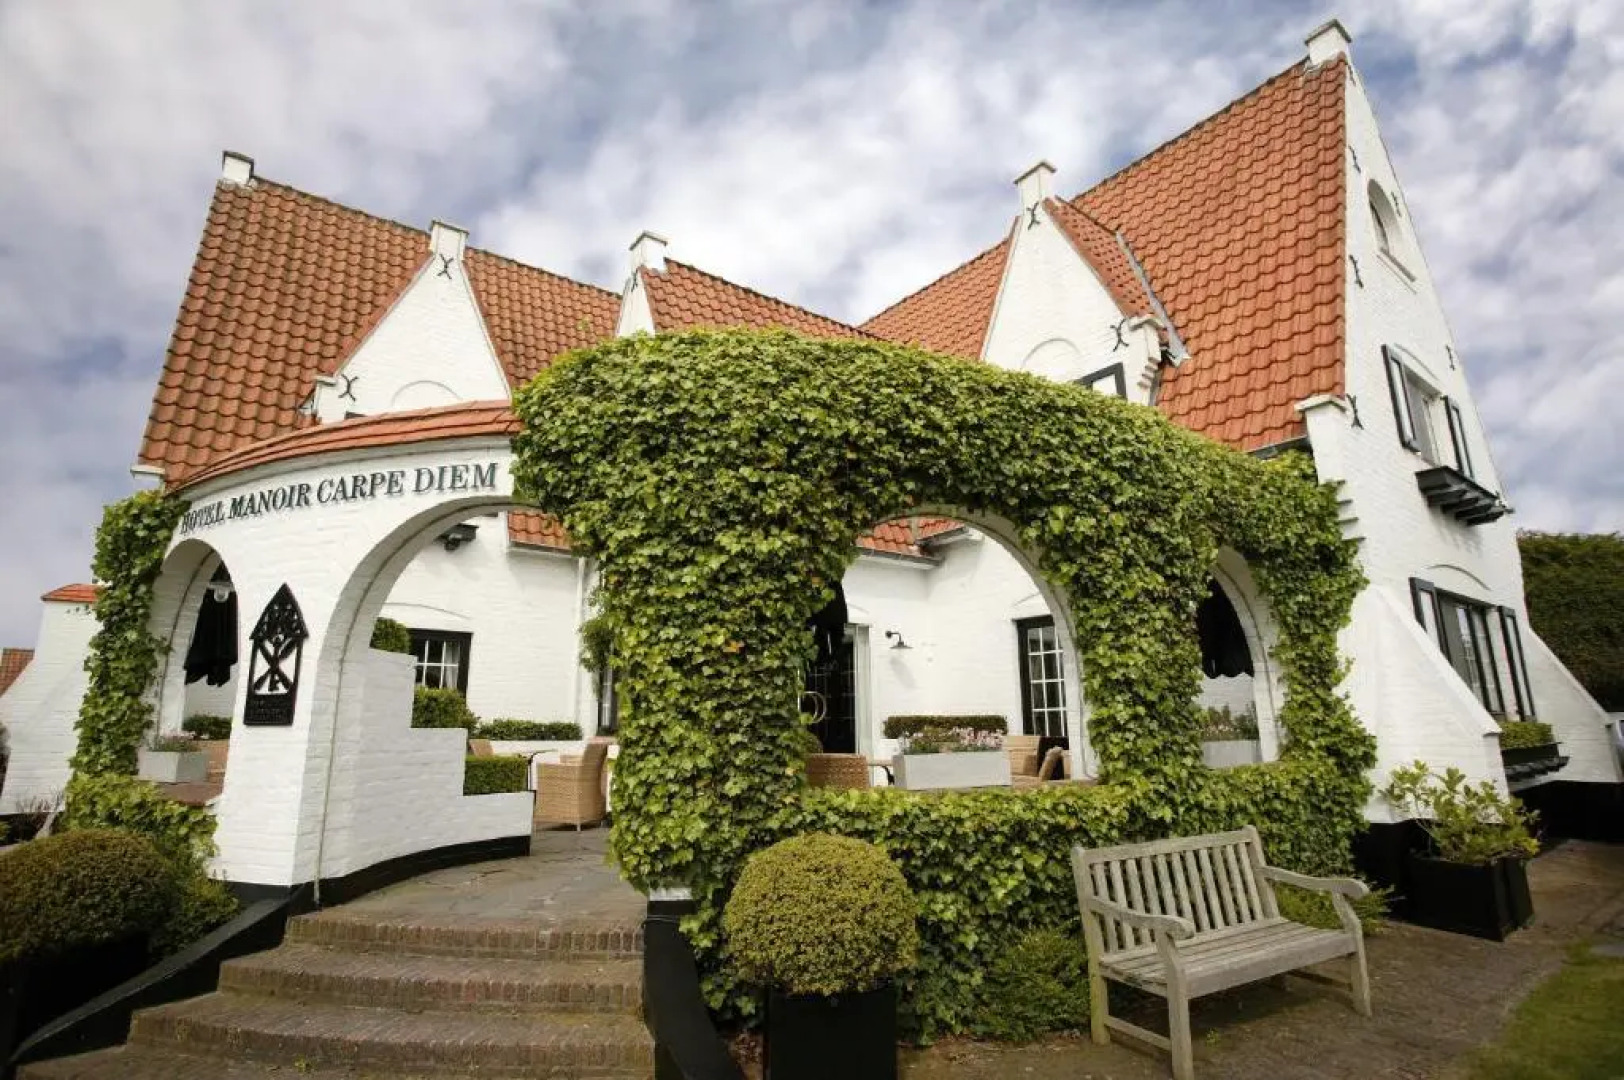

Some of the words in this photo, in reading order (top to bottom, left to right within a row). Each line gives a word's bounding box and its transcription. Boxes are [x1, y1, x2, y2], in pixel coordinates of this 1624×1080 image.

[181, 501, 225, 535] HOTEL
[228, 483, 310, 519] MANOIR
[317, 470, 404, 503] CARPE
[414, 462, 498, 493] DIEM
